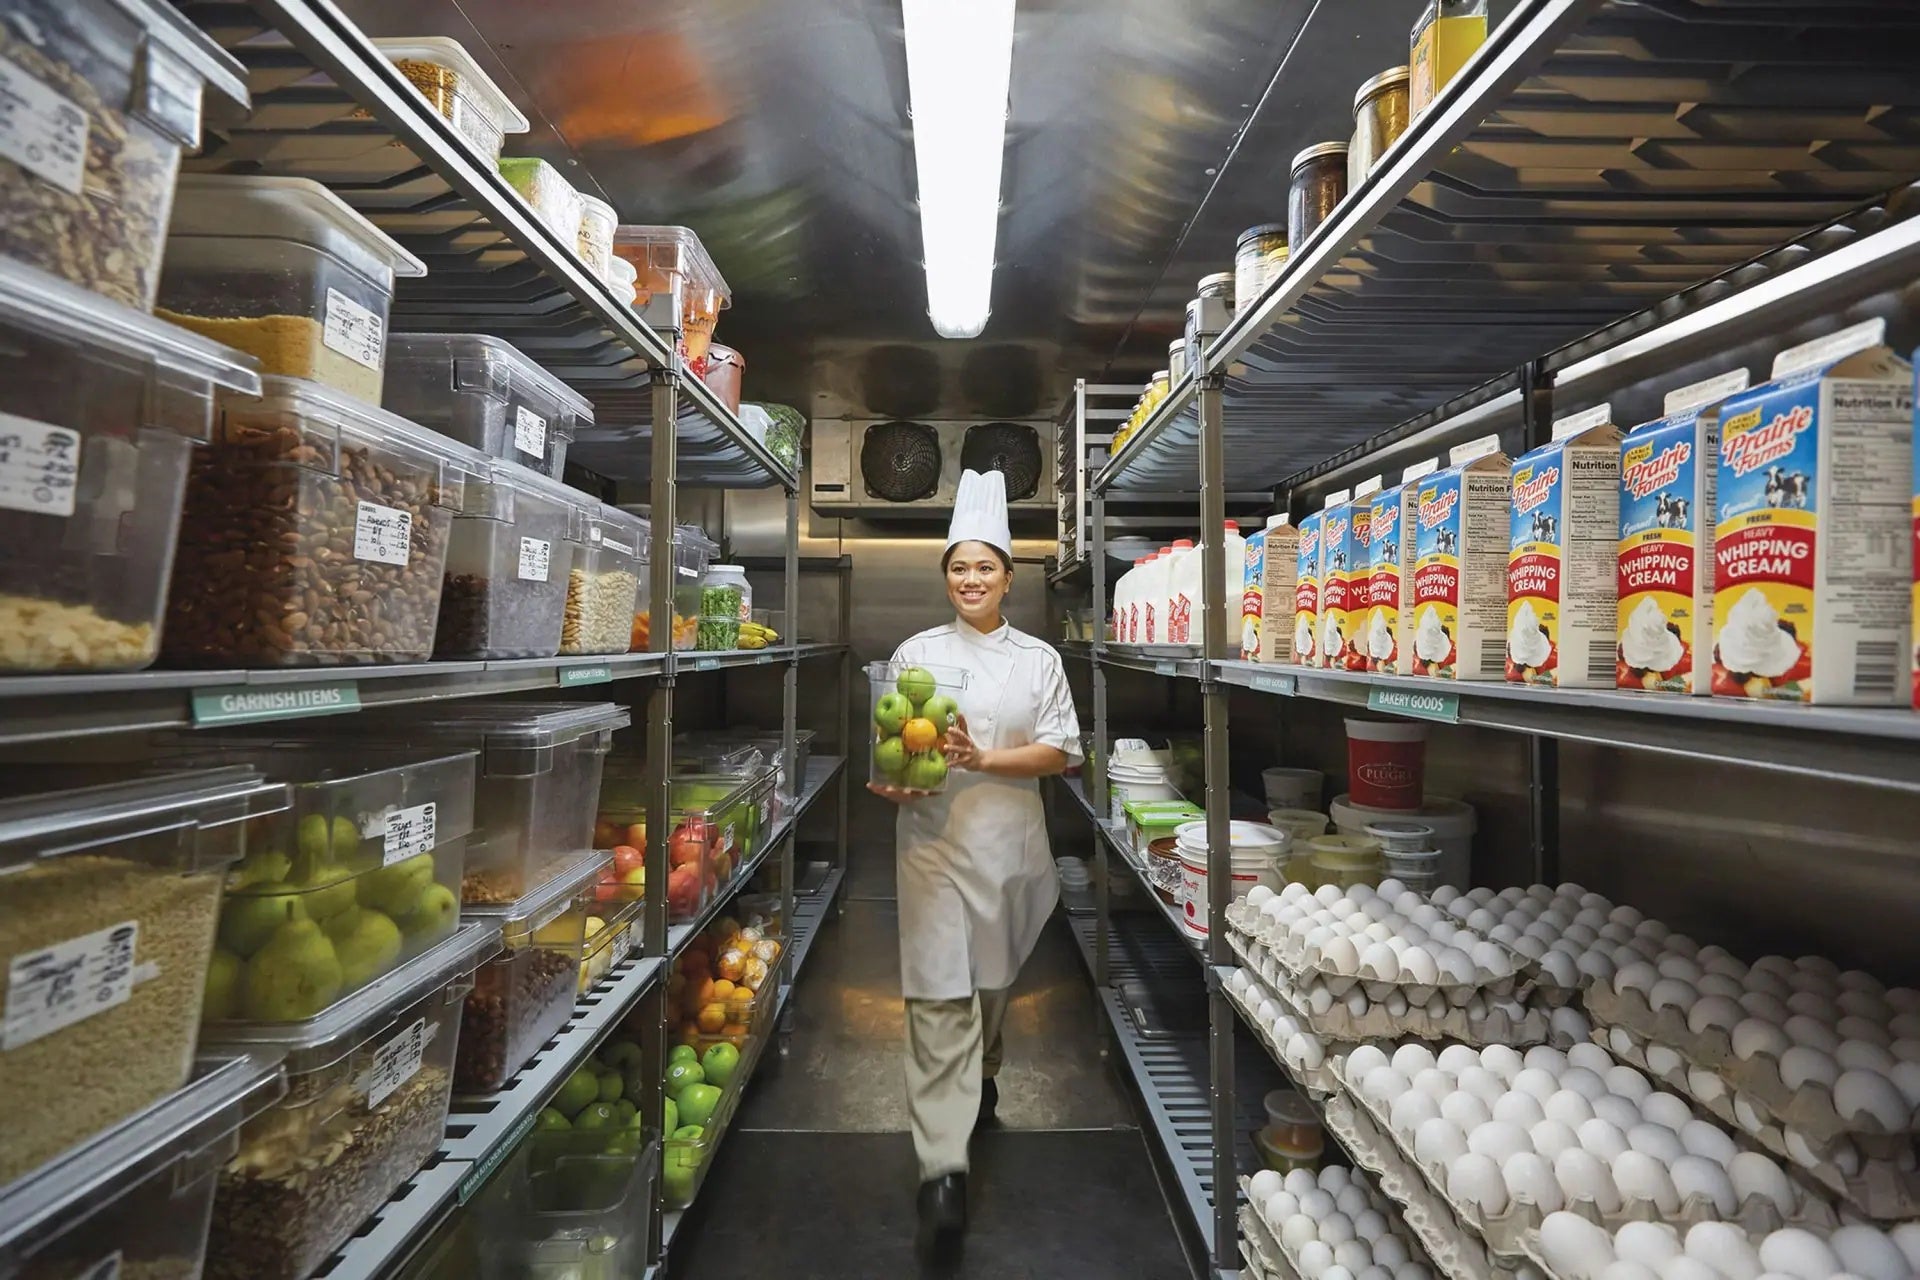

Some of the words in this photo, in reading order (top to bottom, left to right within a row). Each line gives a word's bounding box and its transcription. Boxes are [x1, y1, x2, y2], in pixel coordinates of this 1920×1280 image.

[1834, 397, 1892, 409] Nutrition
[1723, 408, 1811, 463] Prairie
[1623, 442, 1690, 488] Prairie
[1735, 438, 1795, 475] Farms
[1572, 461, 1617, 470] Nutrition
[1468, 484, 1505, 493] Nutrition
[1512, 467, 1558, 507] Prairie
[1634, 468, 1677, 499] Farms
[1419, 488, 1458, 522] Prairie
[1518, 490, 1549, 514] Farms
[1746, 514, 1772, 524] FRESH
[1642, 532, 1662, 541] FRESH
[1743, 527, 1775, 539] HEAVY
[1640, 544, 1664, 553] HEAVY
[1717, 539, 1809, 566] WHIPPING
[1521, 555, 1538, 564] HEAVY
[1620, 555, 1689, 577] WHIPPING
[1727, 558, 1792, 578] CREAM
[1415, 573, 1456, 589] WHIPPING
[1509, 565, 1556, 584] WHIPPING
[1628, 571, 1676, 587] CREAM
[1369, 581, 1397, 595] WHIPPING
[1420, 585, 1448, 598] CREAM
[1513, 579, 1547, 593] CREAM
[1371, 591, 1391, 602] CREAM
[220, 691, 296, 713] GARNISH
[299, 688, 342, 706] ITEMS
[1379, 691, 1410, 708] BAKERY
[1410, 694, 1444, 712] GOODS
[463, 1172, 480, 1194] MAIN
